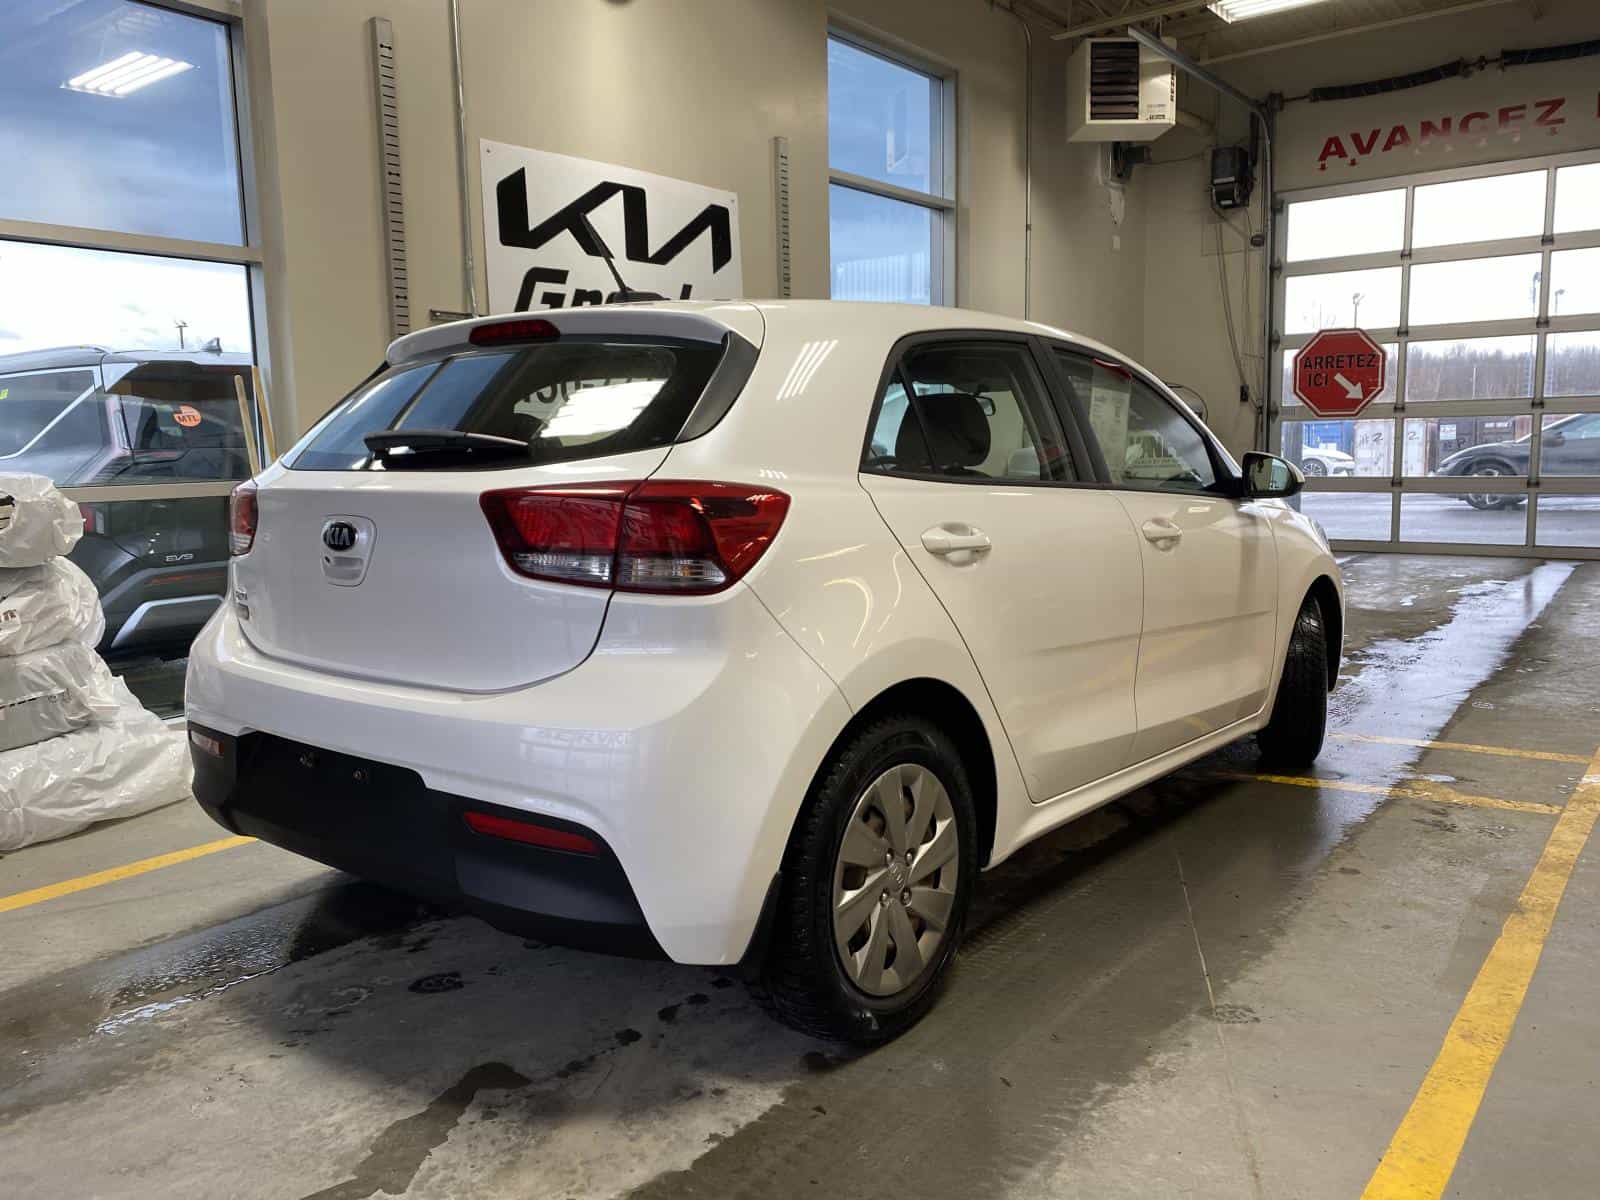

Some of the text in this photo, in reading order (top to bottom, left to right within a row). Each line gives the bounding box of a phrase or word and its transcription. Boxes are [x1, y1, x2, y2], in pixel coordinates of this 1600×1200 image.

[1317, 97, 1567, 167] AVANCEZ
[496, 165, 732, 275] KIA
[1303, 353, 1377, 370] ARRETEZ
[1307, 373, 1329, 387] ICI
[326, 527, 352, 546] KIA
